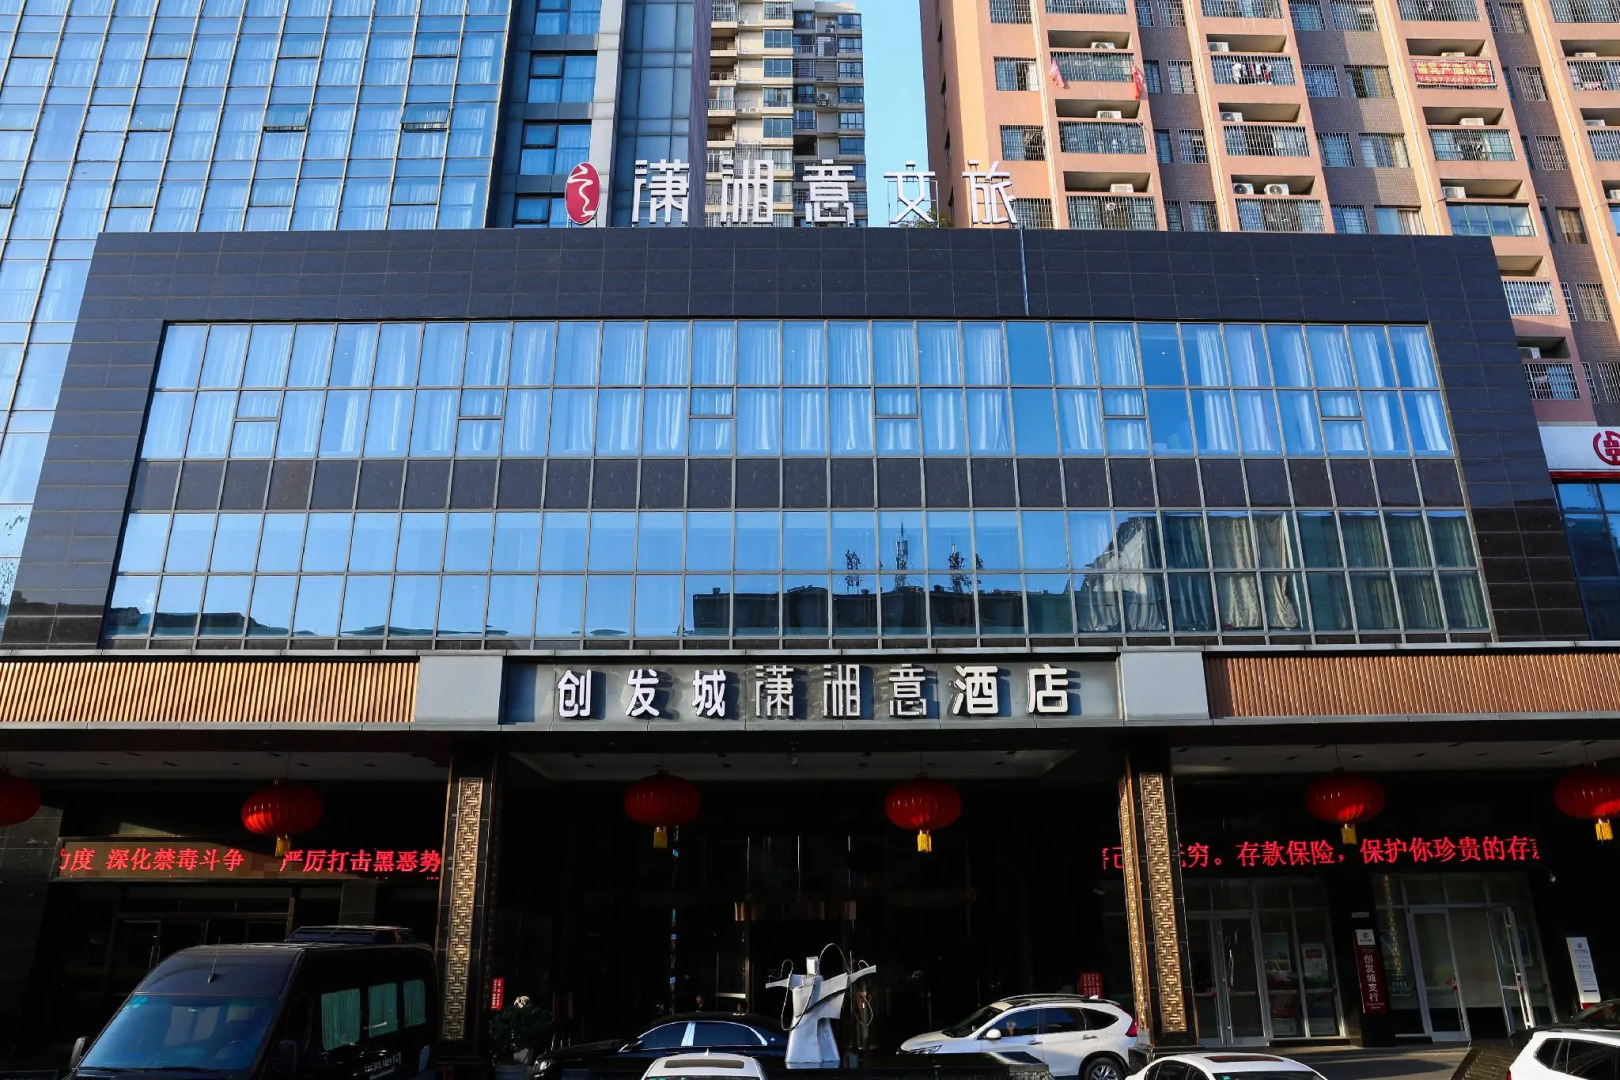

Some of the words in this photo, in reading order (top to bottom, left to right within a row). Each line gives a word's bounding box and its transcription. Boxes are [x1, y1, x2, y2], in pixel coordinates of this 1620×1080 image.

[556, 663, 1069, 718] 创发城潇湘意酒店
[106, 848, 245, 872] 深化禁毒斗争
[280, 850, 443, 873] 严厉打击黑恶势
